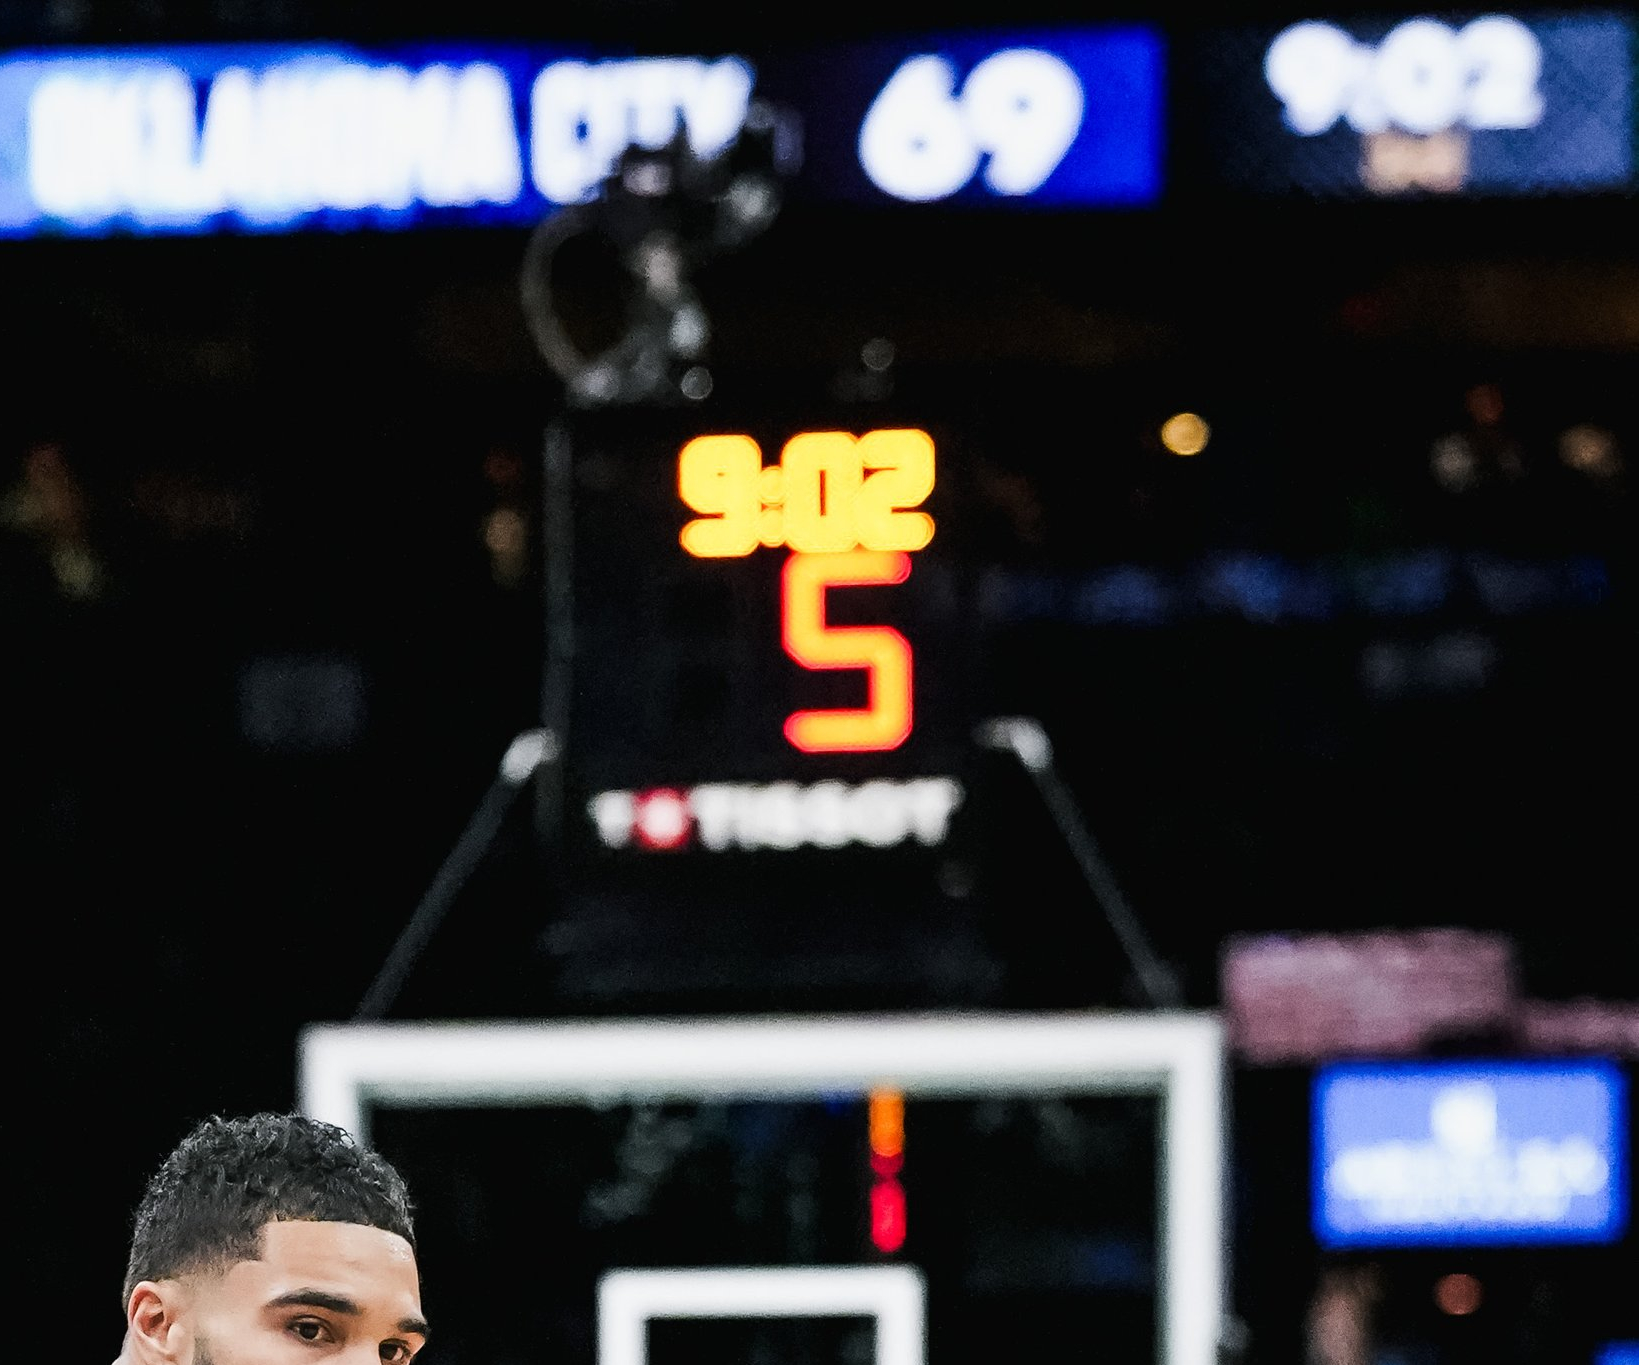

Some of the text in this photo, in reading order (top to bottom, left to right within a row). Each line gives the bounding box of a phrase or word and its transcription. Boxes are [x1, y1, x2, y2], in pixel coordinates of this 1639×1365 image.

[859, 48, 1084, 202] 69
[1265, 17, 1545, 136] 9:02
[679, 428, 936, 558] 9:02
[781, 550, 913, 754] 5
